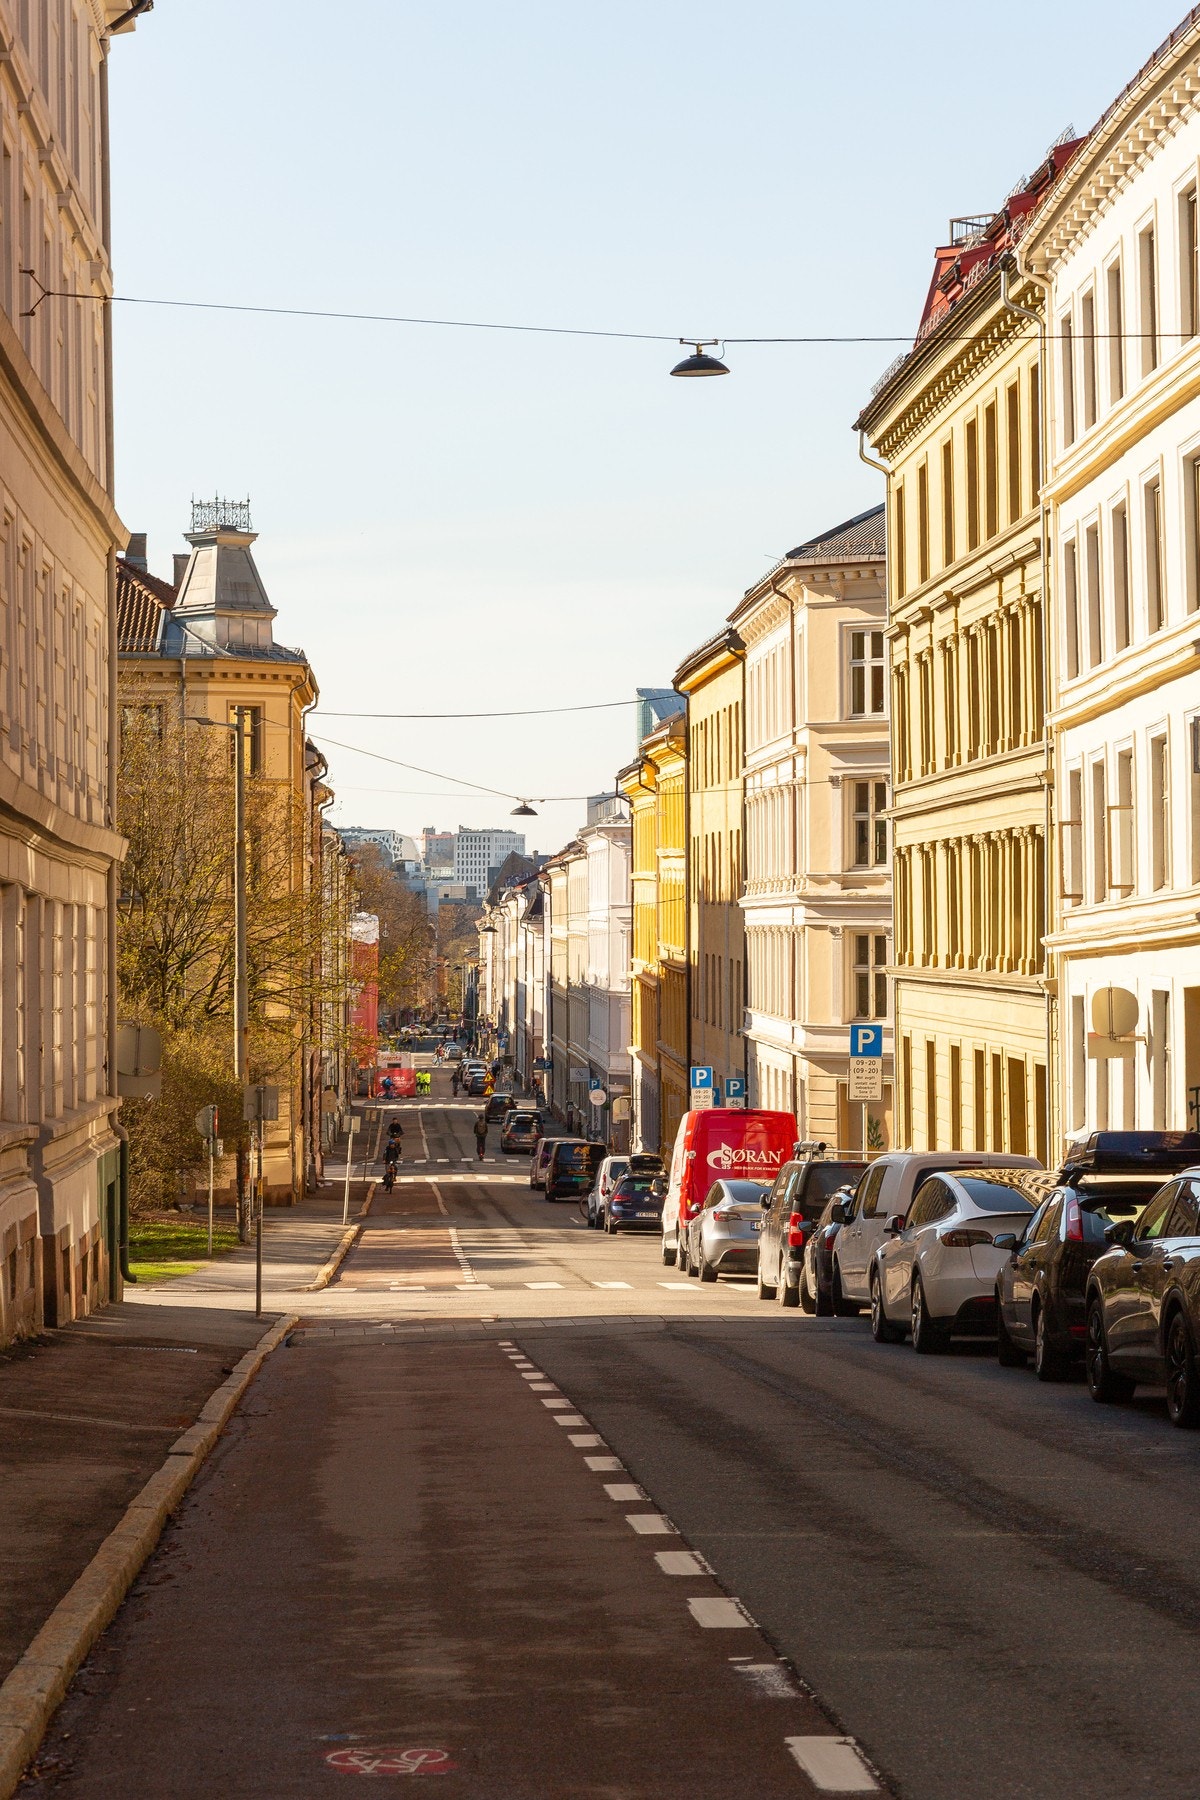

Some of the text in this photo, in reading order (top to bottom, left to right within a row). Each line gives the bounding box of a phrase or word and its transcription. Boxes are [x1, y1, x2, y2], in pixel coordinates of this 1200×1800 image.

[858, 1029, 875, 1053] P
[696, 1069, 708, 1086] P
[729, 1080, 741, 1096] P
[722, 1149, 781, 1164] SØRAN
